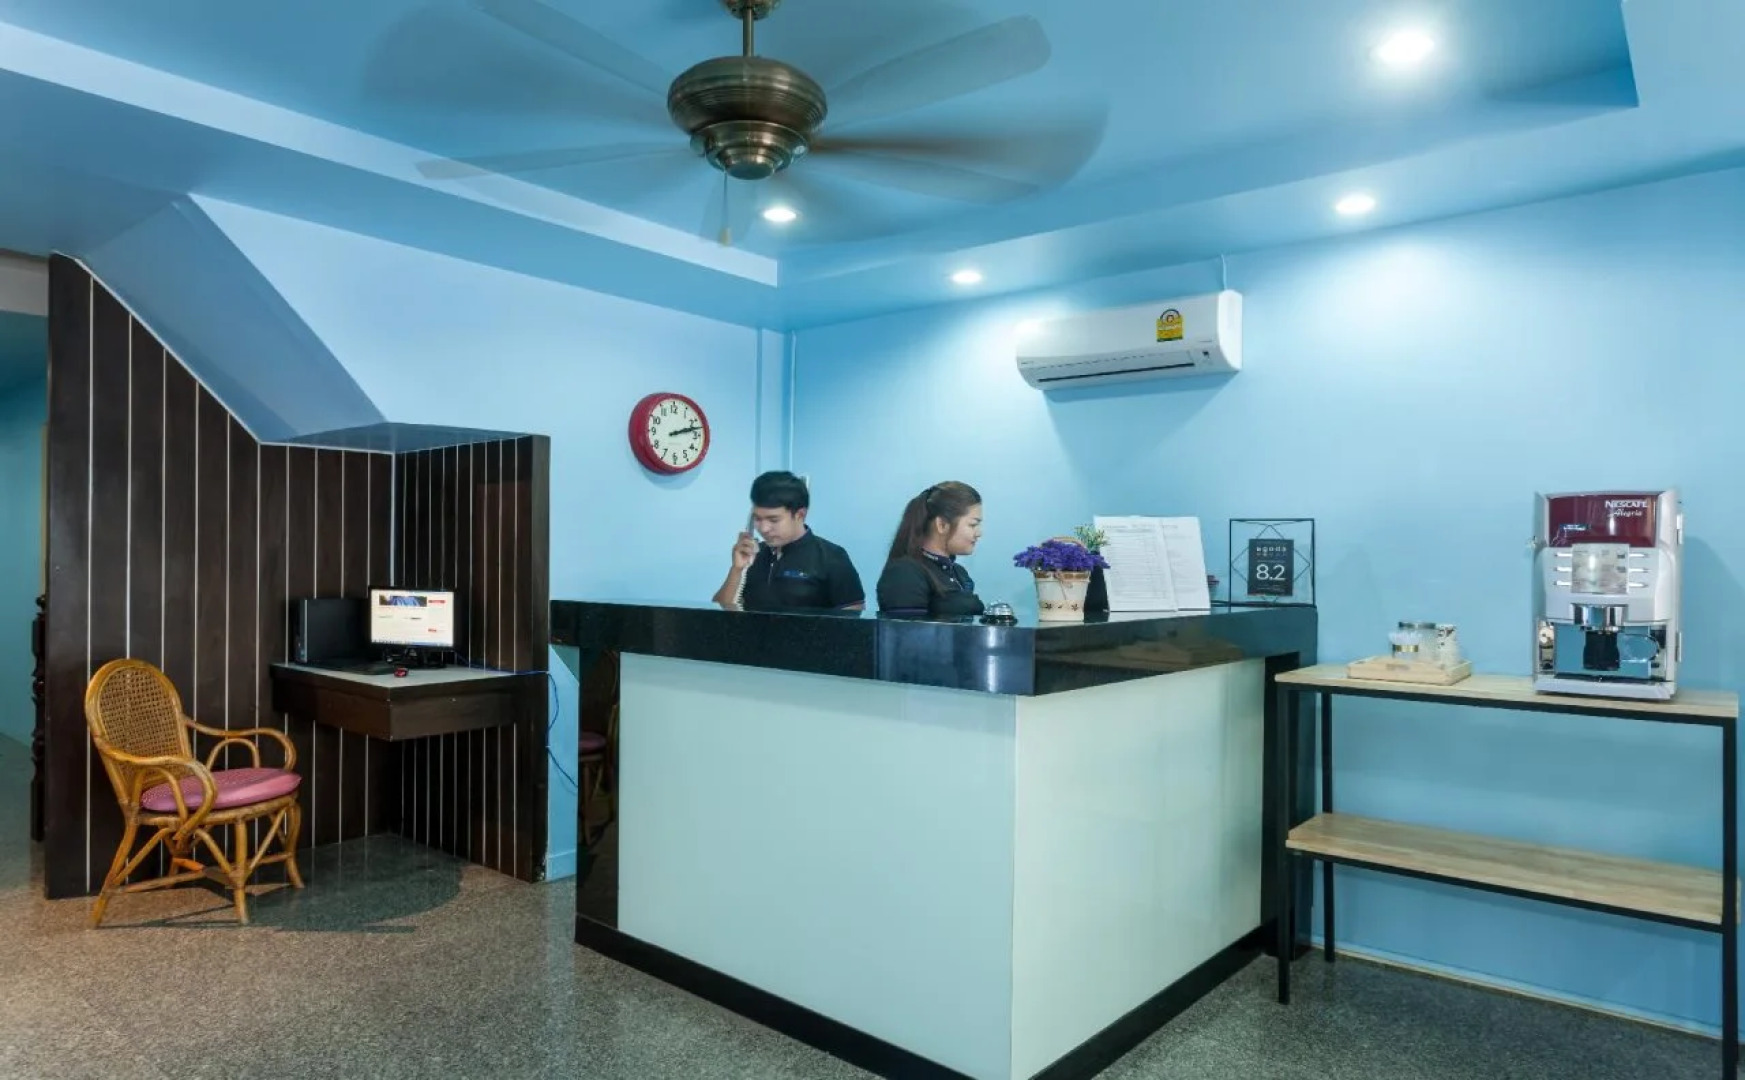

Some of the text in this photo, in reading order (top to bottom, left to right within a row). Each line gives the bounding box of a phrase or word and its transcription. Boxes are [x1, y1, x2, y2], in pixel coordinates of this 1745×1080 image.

[661, 408, 667, 416] 11
[670, 405, 678, 414] 12
[653, 416, 661, 425] 10
[689, 419, 695, 428] 2
[651, 427, 657, 436] 9
[692, 431, 698, 440] 3
[654, 440, 659, 449] 8
[663, 448, 669, 458] 7
[672, 453, 678, 462] 6
[682, 450, 688, 458] 5
[1256, 563, 1286, 580] 8.2
